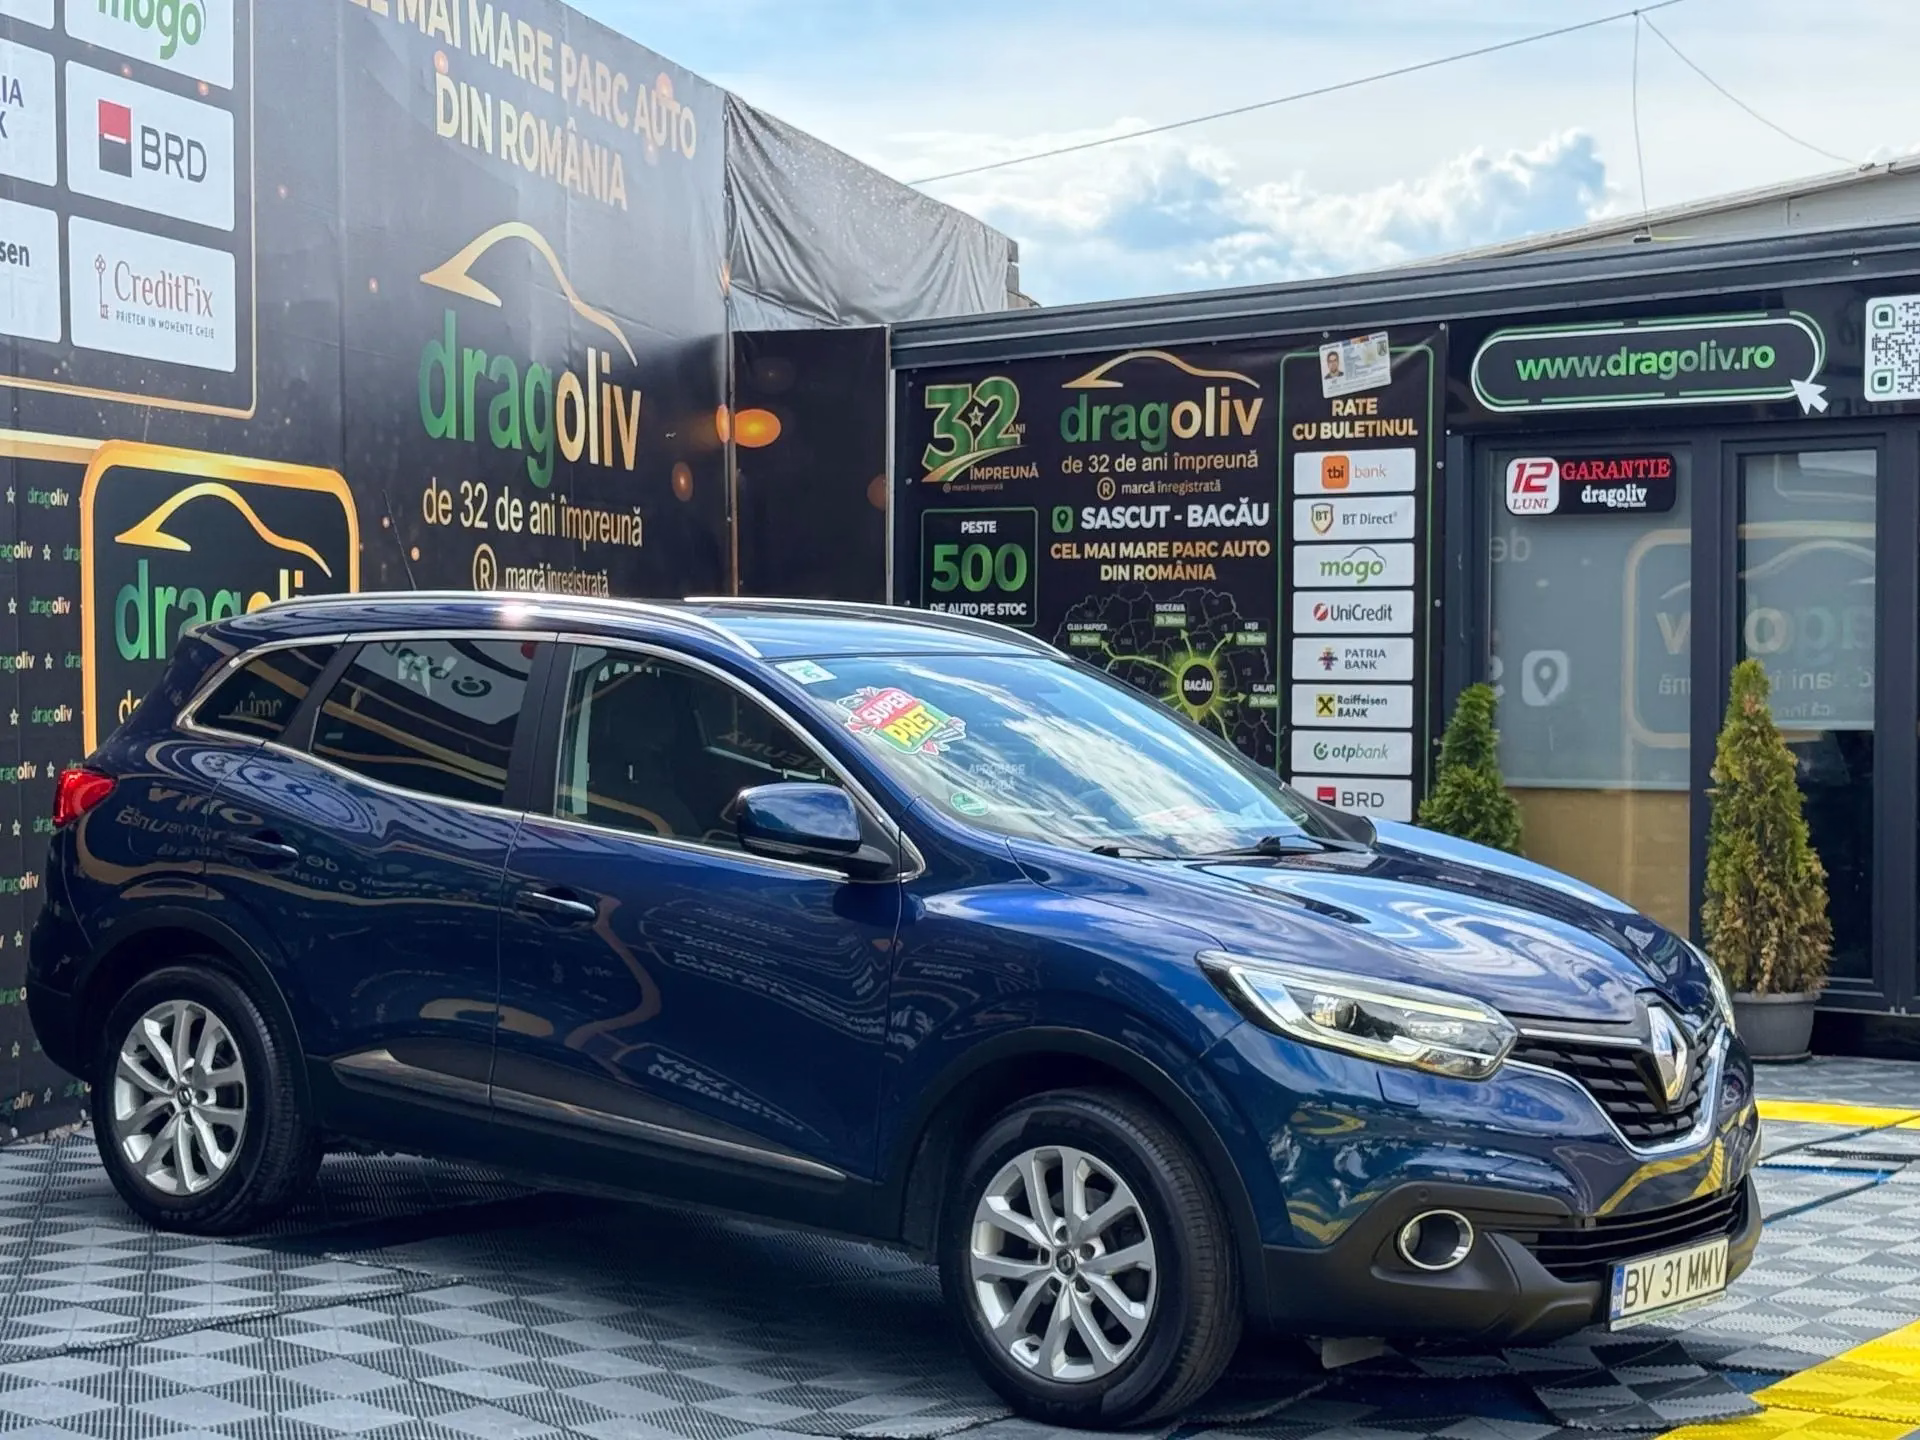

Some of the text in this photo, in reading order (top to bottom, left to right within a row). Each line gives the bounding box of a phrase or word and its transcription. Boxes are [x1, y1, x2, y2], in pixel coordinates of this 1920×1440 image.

[469, 0, 555, 93] MARE
[561, 43, 629, 128] PARC
[634, 82, 697, 159] AUTO
[436, 73, 627, 211] DIN ROMÂNIA
[140, 125, 207, 183] BRD
[114, 260, 213, 318] CreditFix
[1515, 339, 1776, 381] www.dragoliv.ro
[419, 309, 642, 488] dragoliv
[1332, 397, 1378, 416] RATE
[922, 376, 1020, 472] 32
[1060, 386, 1264, 452] dragoliv
[1292, 418, 1419, 440] CU BULETINUL
[1061, 449, 1259, 475] de 32 de ani împreună
[1326, 463, 1387, 479] tbi bank
[1512, 458, 1672, 494] 12 GARANTIE
[28, 487, 69, 509] dragoliv
[1121, 480, 1155, 495] marcă
[1157, 478, 1222, 497] înregistrată
[1581, 483, 1648, 507] dragoliv
[423, 477, 643, 551] de 32 de ani împreună
[1080, 504, 1171, 530] SASCUT
[1187, 497, 1270, 528] BACĂU
[1513, 498, 1549, 510] LUNI
[961, 521, 997, 534] PESTE
[1342, 513, 1357, 525] BT
[1050, 539, 1271, 559] CEL MAI MARE PARC AUTO
[505, 563, 546, 592] marcă
[931, 544, 1027, 592] 500
[1100, 560, 1217, 582] DIN ROMÂNIA
[1320, 560, 1384, 584] mogo
[29, 597, 70, 617] dragoliv
[948, 603, 979, 615] AUTO
[980, 603, 996, 615] PE
[997, 603, 1027, 615] STOC
[1330, 604, 1393, 622] UniCredit
[1345, 648, 1387, 659] PATRIA
[1345, 660, 1377, 670] BANK
[1183, 676, 1213, 692] BACĂU
[862, 690, 919, 726] SUPER
[1337, 694, 1388, 706] Raiffeisen
[32, 704, 72, 726] dragoliv
[1337, 708, 1368, 718] BANK
[1332, 742, 1389, 762] otpbank
[1341, 791, 1385, 808] BRD
[1623, 1245, 1727, 1309] BV 31 MMV
